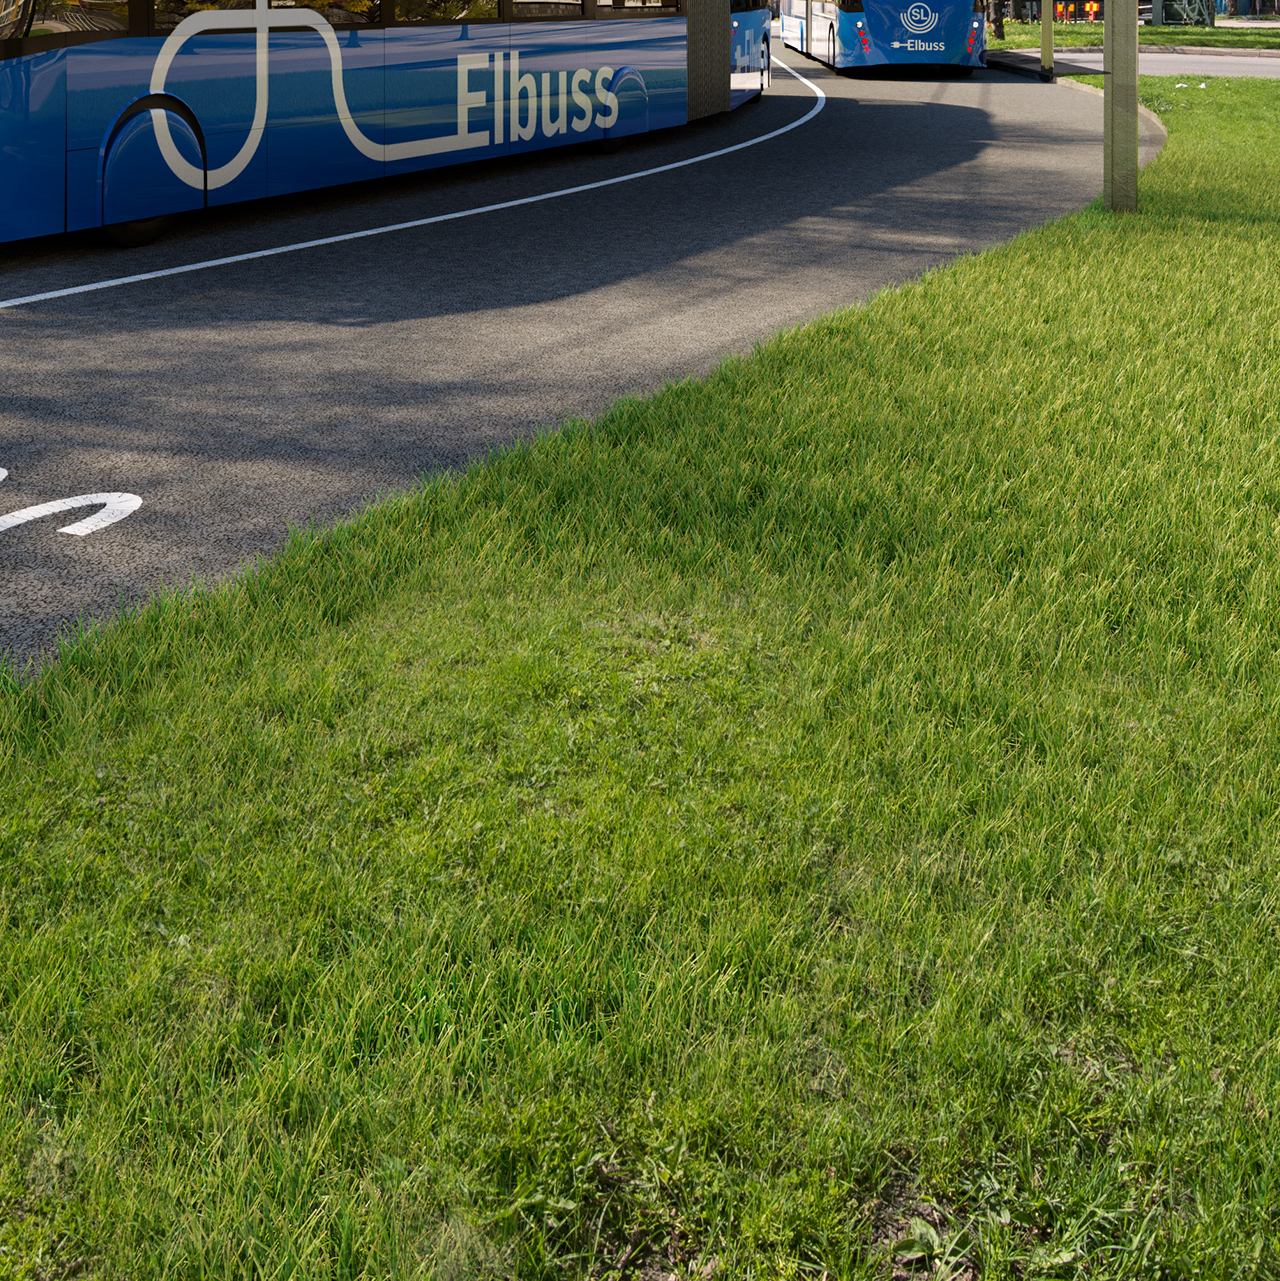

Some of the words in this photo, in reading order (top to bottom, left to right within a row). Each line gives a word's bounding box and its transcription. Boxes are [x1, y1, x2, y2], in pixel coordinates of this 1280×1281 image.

[911, 8, 928, 21] SL
[907, 39, 946, 51] Elbuss
[457, 50, 619, 146] Elbuss
